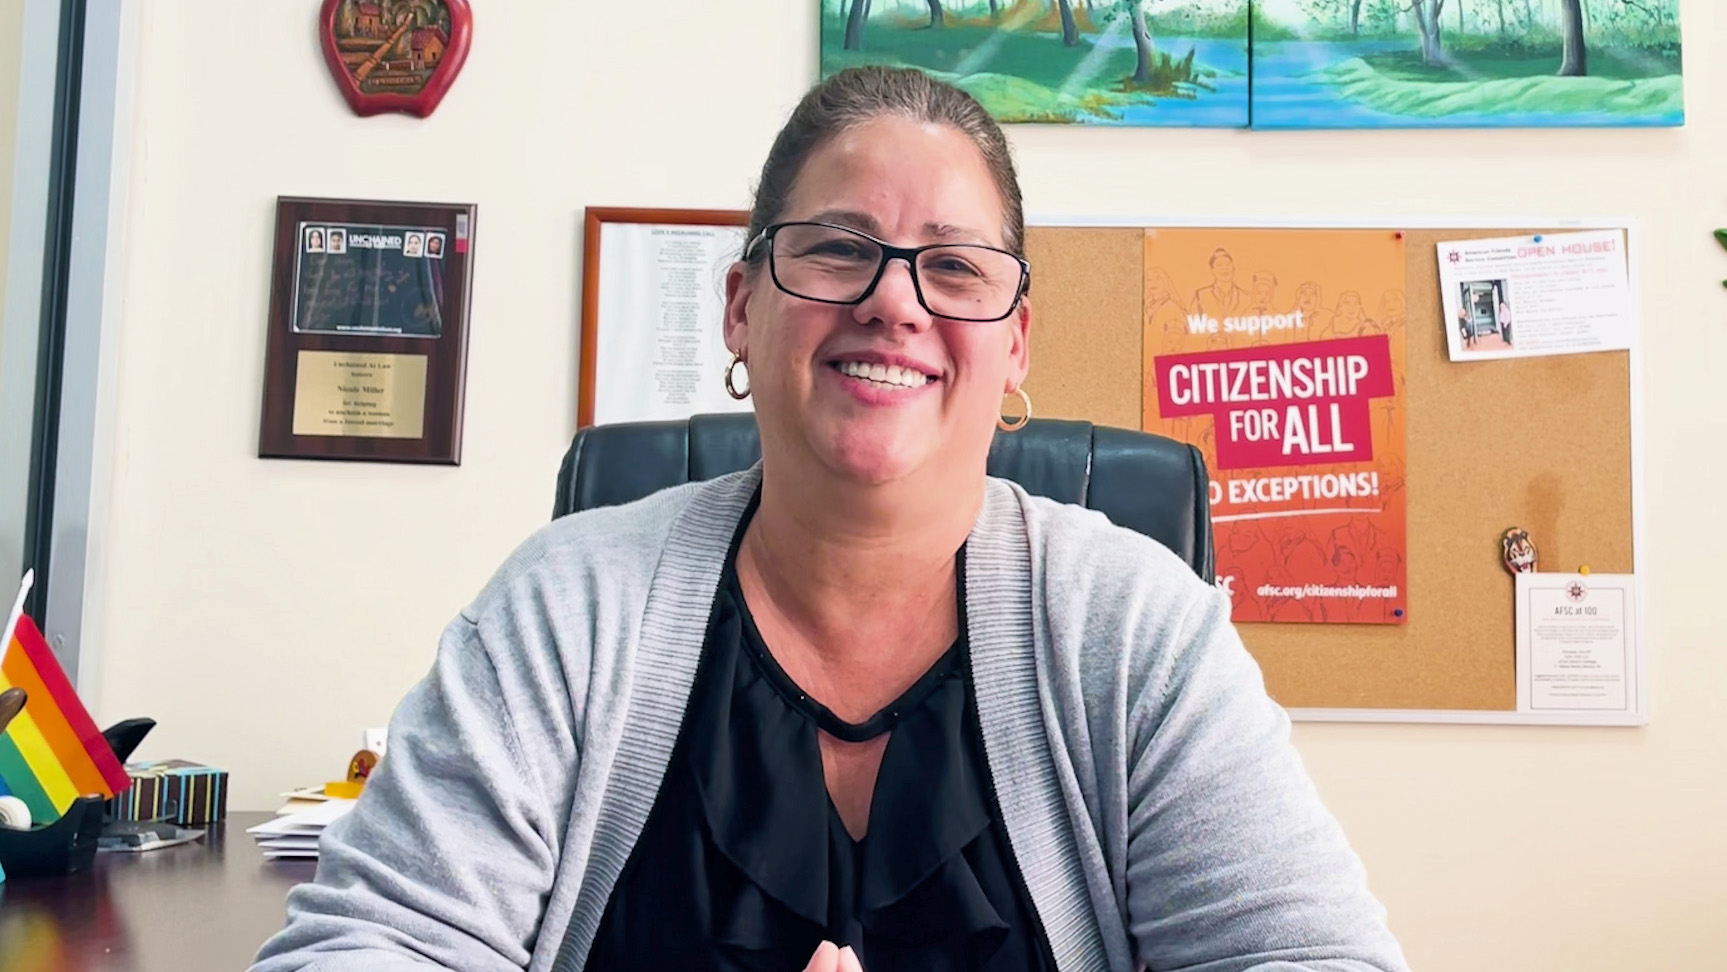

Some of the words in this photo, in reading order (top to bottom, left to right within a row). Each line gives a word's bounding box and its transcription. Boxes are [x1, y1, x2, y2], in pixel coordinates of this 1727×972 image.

[349, 234, 402, 246] UNCHAINED
[1517, 244, 1556, 258] OPEN
[1562, 239, 1616, 255] HOUSE!
[1187, 314, 1218, 333] We
[1224, 310, 1304, 335] support
[1169, 354, 1369, 405] CITIZENSHIP
[363, 386, 384, 394] Miller
[1230, 409, 1280, 442] FOR
[1281, 403, 1354, 455] ALL
[1209, 481, 1223, 505] O
[1229, 472, 1379, 505] EXCEPTIONS!
[1257, 584, 1397, 599] afsc.org/citizenshipforall
[1555, 606, 1573, 615] AFSC
[1575, 606, 1582, 615] at
[1585, 606, 1597, 615] 100
